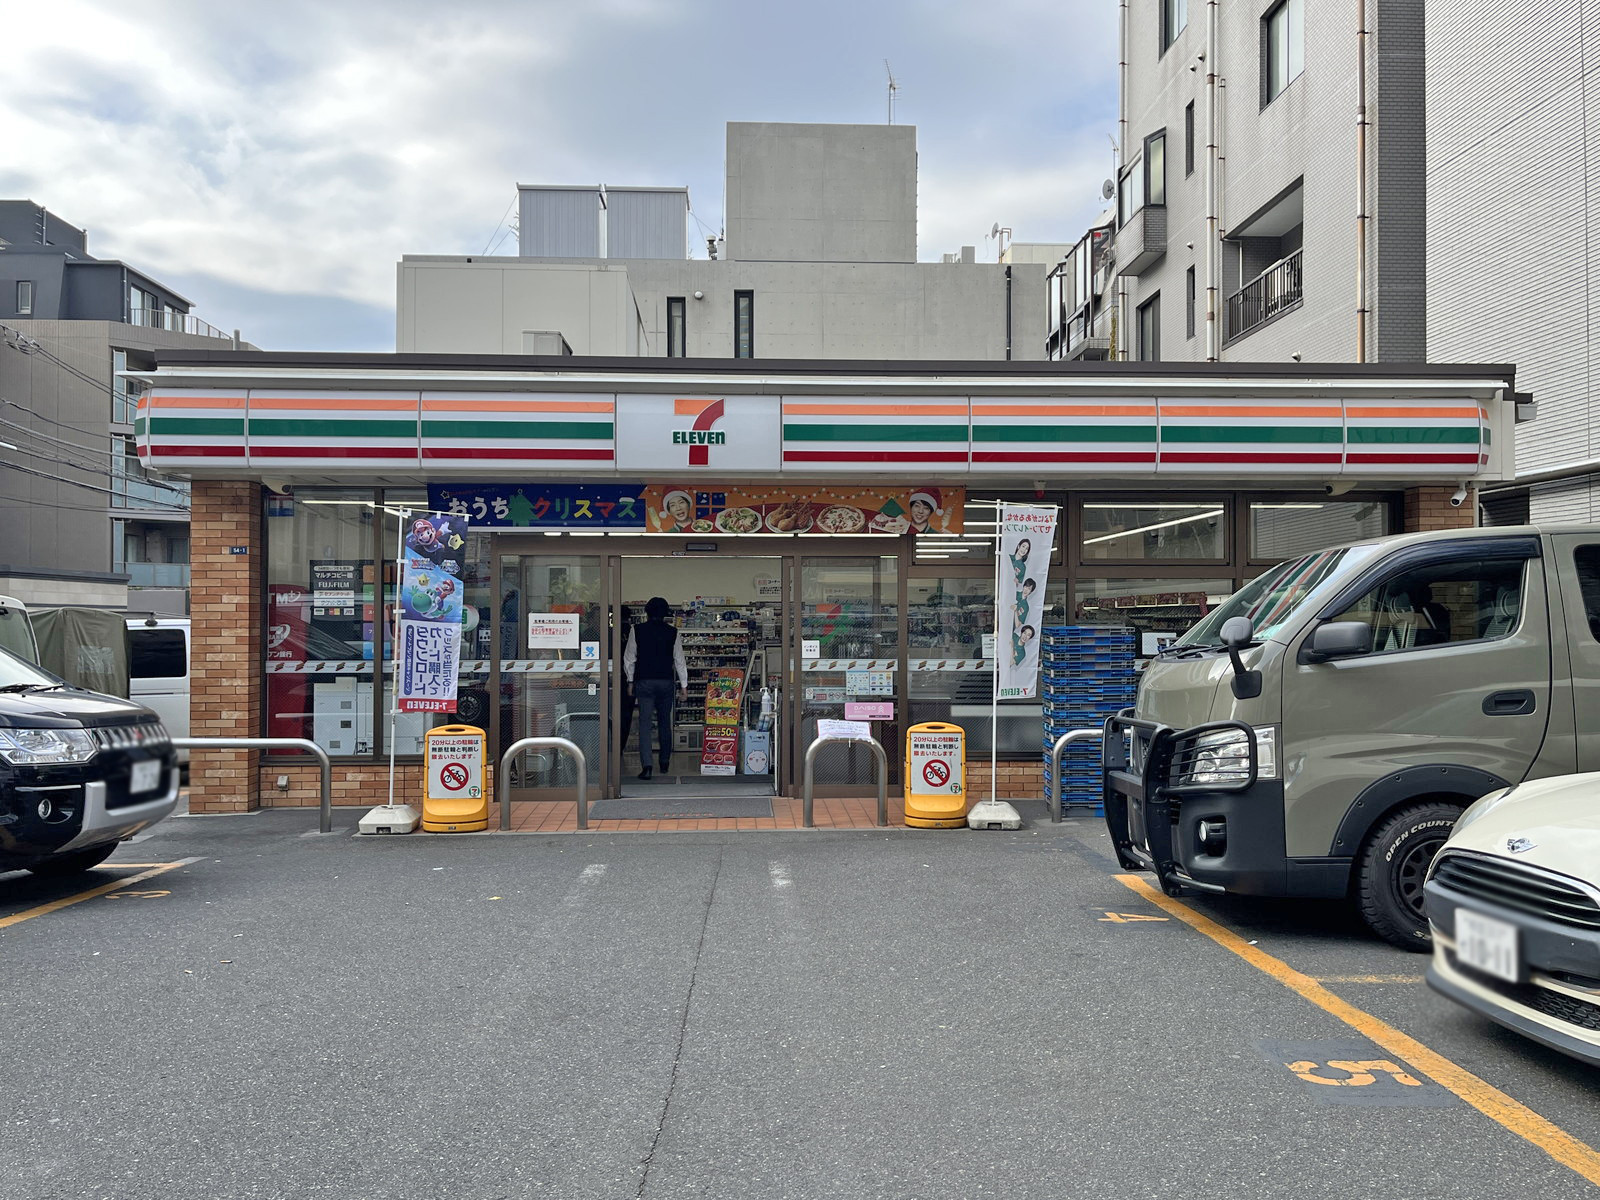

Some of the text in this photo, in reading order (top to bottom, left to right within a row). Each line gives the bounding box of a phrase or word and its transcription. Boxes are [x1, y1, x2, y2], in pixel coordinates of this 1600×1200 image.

[448, 496, 637, 520] おうち クリスマス
[1385, 831, 1409, 862] OPEN
[1283, 1060, 1423, 1087] 5
